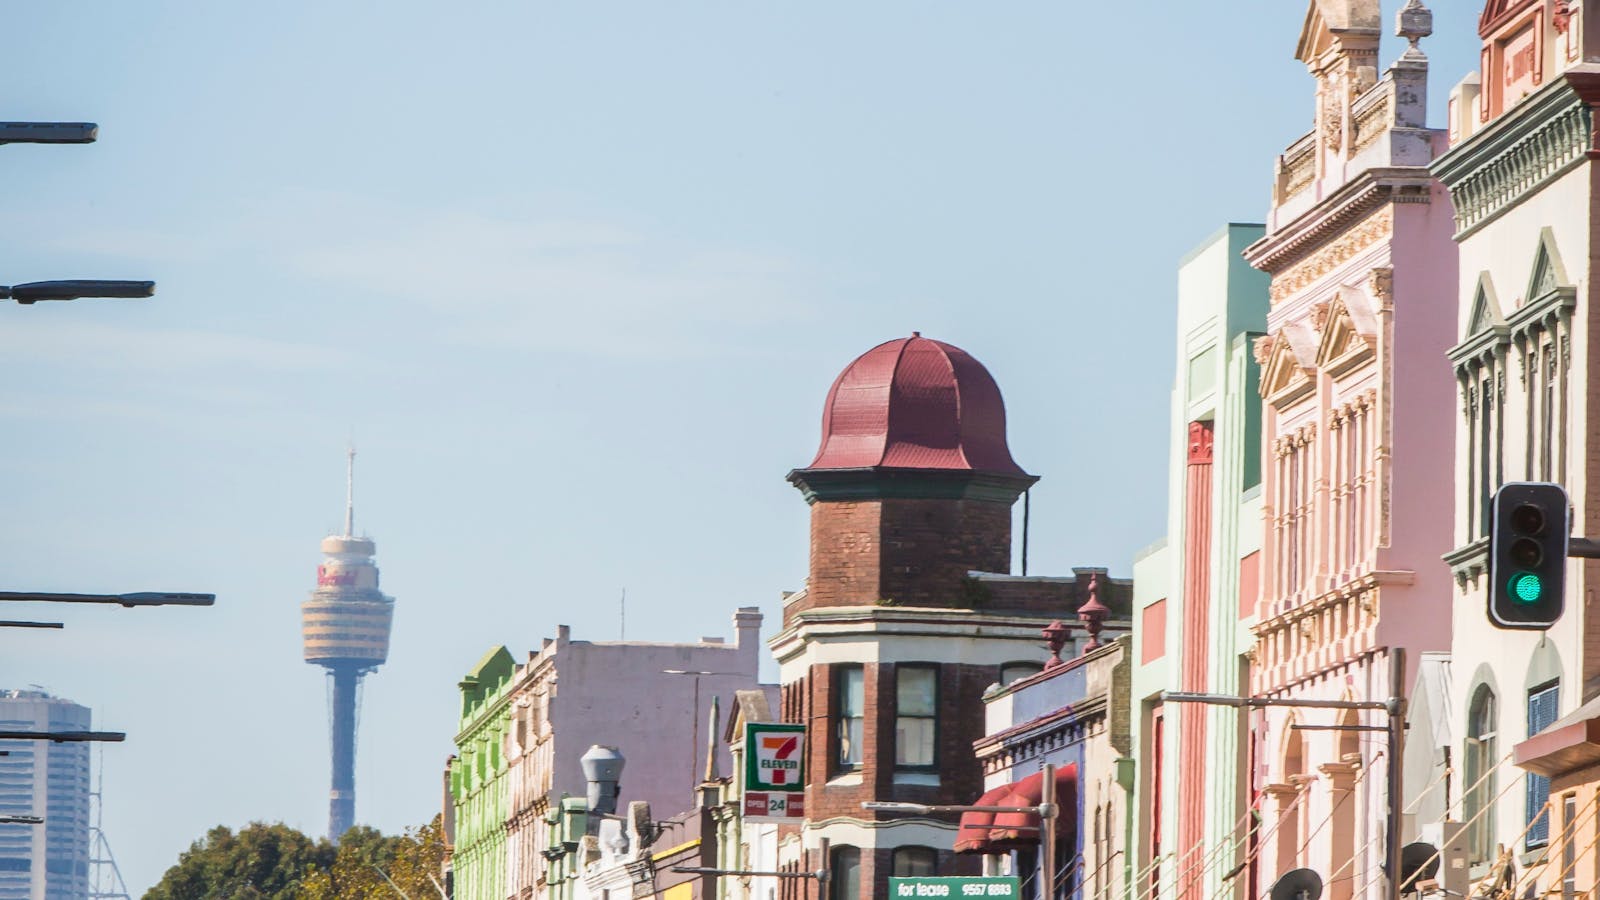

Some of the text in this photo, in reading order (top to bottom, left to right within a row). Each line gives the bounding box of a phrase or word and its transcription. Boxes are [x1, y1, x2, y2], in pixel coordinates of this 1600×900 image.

[763, 737, 797, 759] 7
[770, 800, 785, 810] 24
[898, 883, 915, 896] for
[917, 883, 949, 896] lease
